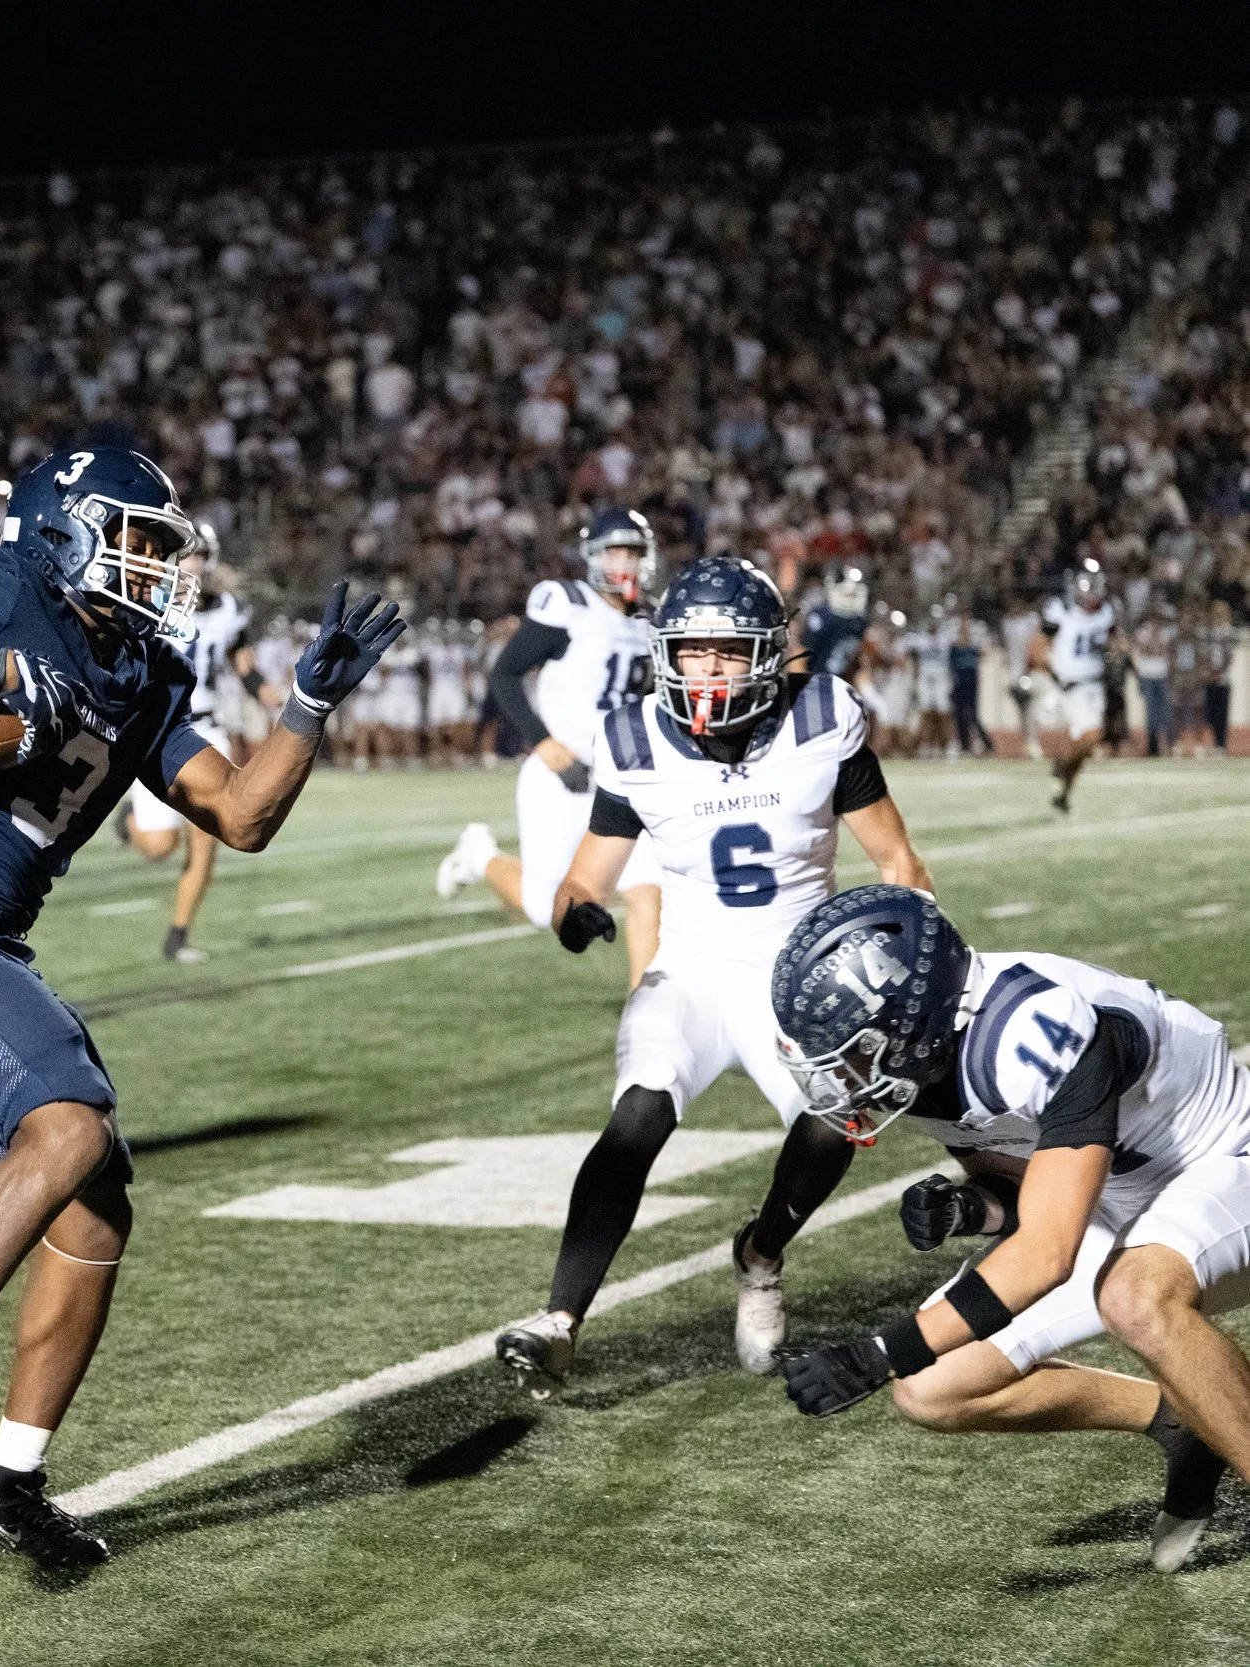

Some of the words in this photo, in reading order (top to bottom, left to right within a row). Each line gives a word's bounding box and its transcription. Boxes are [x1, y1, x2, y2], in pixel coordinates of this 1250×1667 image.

[54, 451, 95, 485] 3
[10, 730, 110, 850] 3
[693, 792, 781, 817] CHAMPION
[710, 823, 778, 908] 6
[834, 940, 912, 1014] 14
[1014, 1010, 1085, 1092] 14
